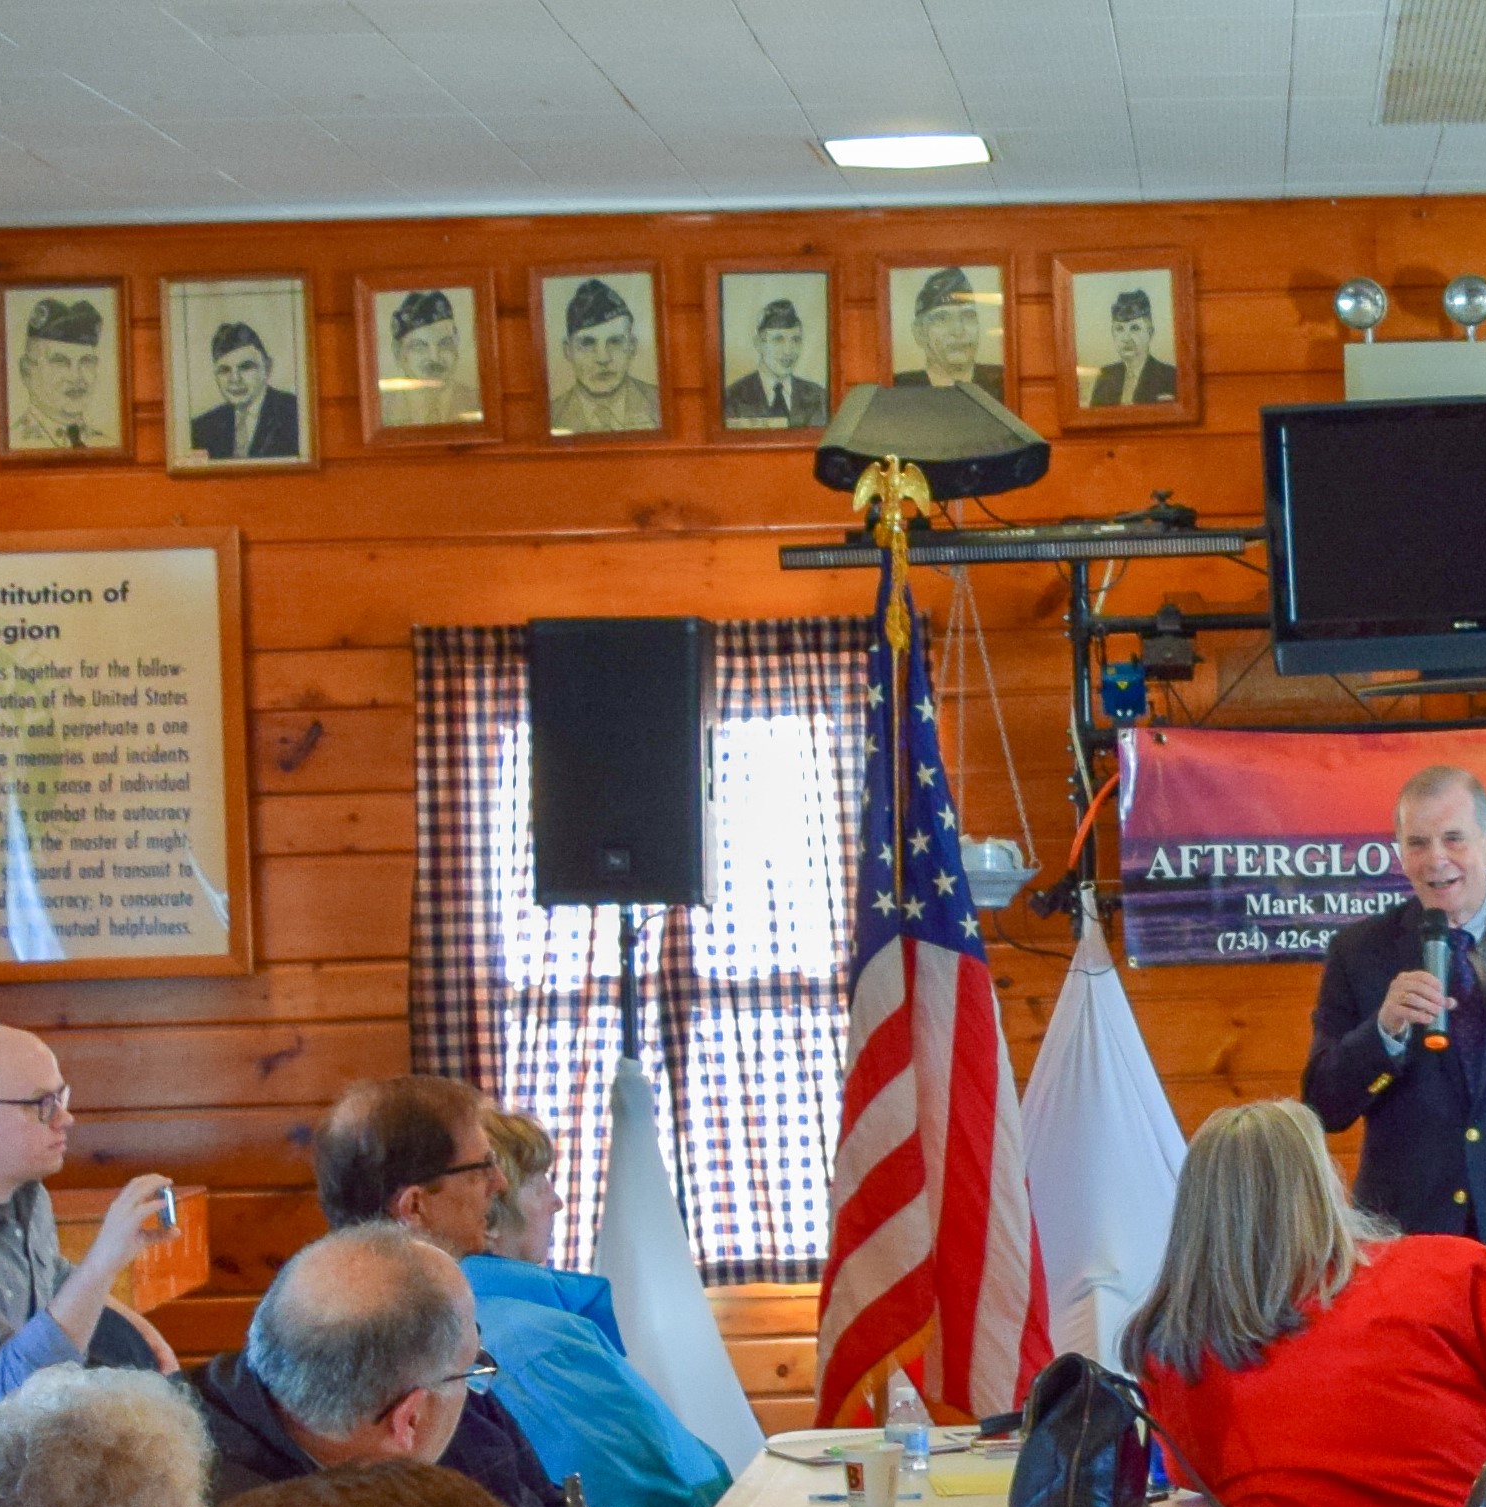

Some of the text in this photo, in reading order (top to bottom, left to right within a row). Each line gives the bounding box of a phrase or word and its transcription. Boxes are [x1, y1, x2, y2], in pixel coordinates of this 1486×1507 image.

[103, 580, 130, 603] of
[146, 722, 155, 734] a
[38, 780, 46, 794] a
[1245, 893, 1315, 916] Mark
[1217, 931, 1269, 954] (734)
[1275, 930, 1336, 949] 426-8
